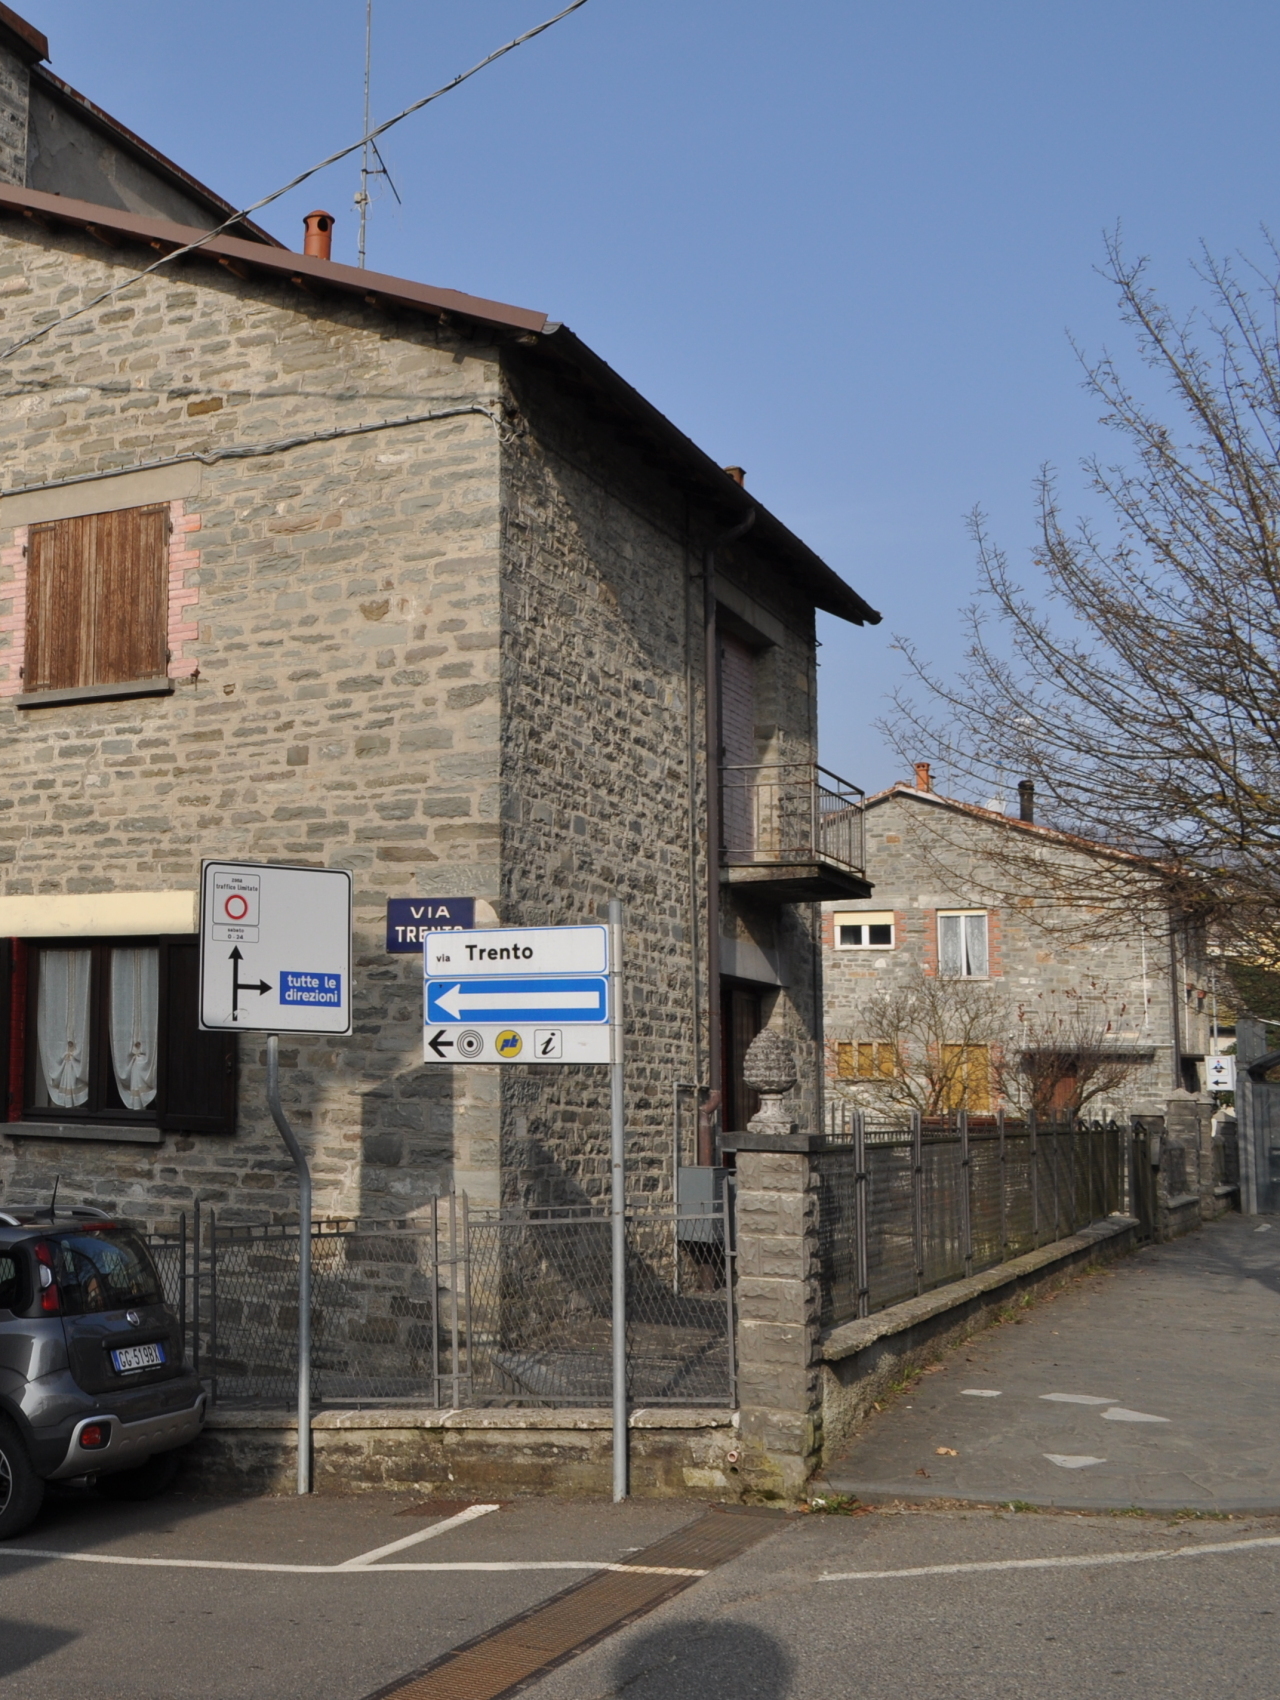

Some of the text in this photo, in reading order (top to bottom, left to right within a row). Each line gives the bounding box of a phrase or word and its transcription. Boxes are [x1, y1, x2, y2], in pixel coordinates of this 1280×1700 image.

[410, 906, 450, 919] VIA
[395, 926, 464, 943] TRE
[436, 943, 533, 963] via Trento
[287, 974, 337, 989] tutte le
[285, 988, 338, 1003] direzioni
